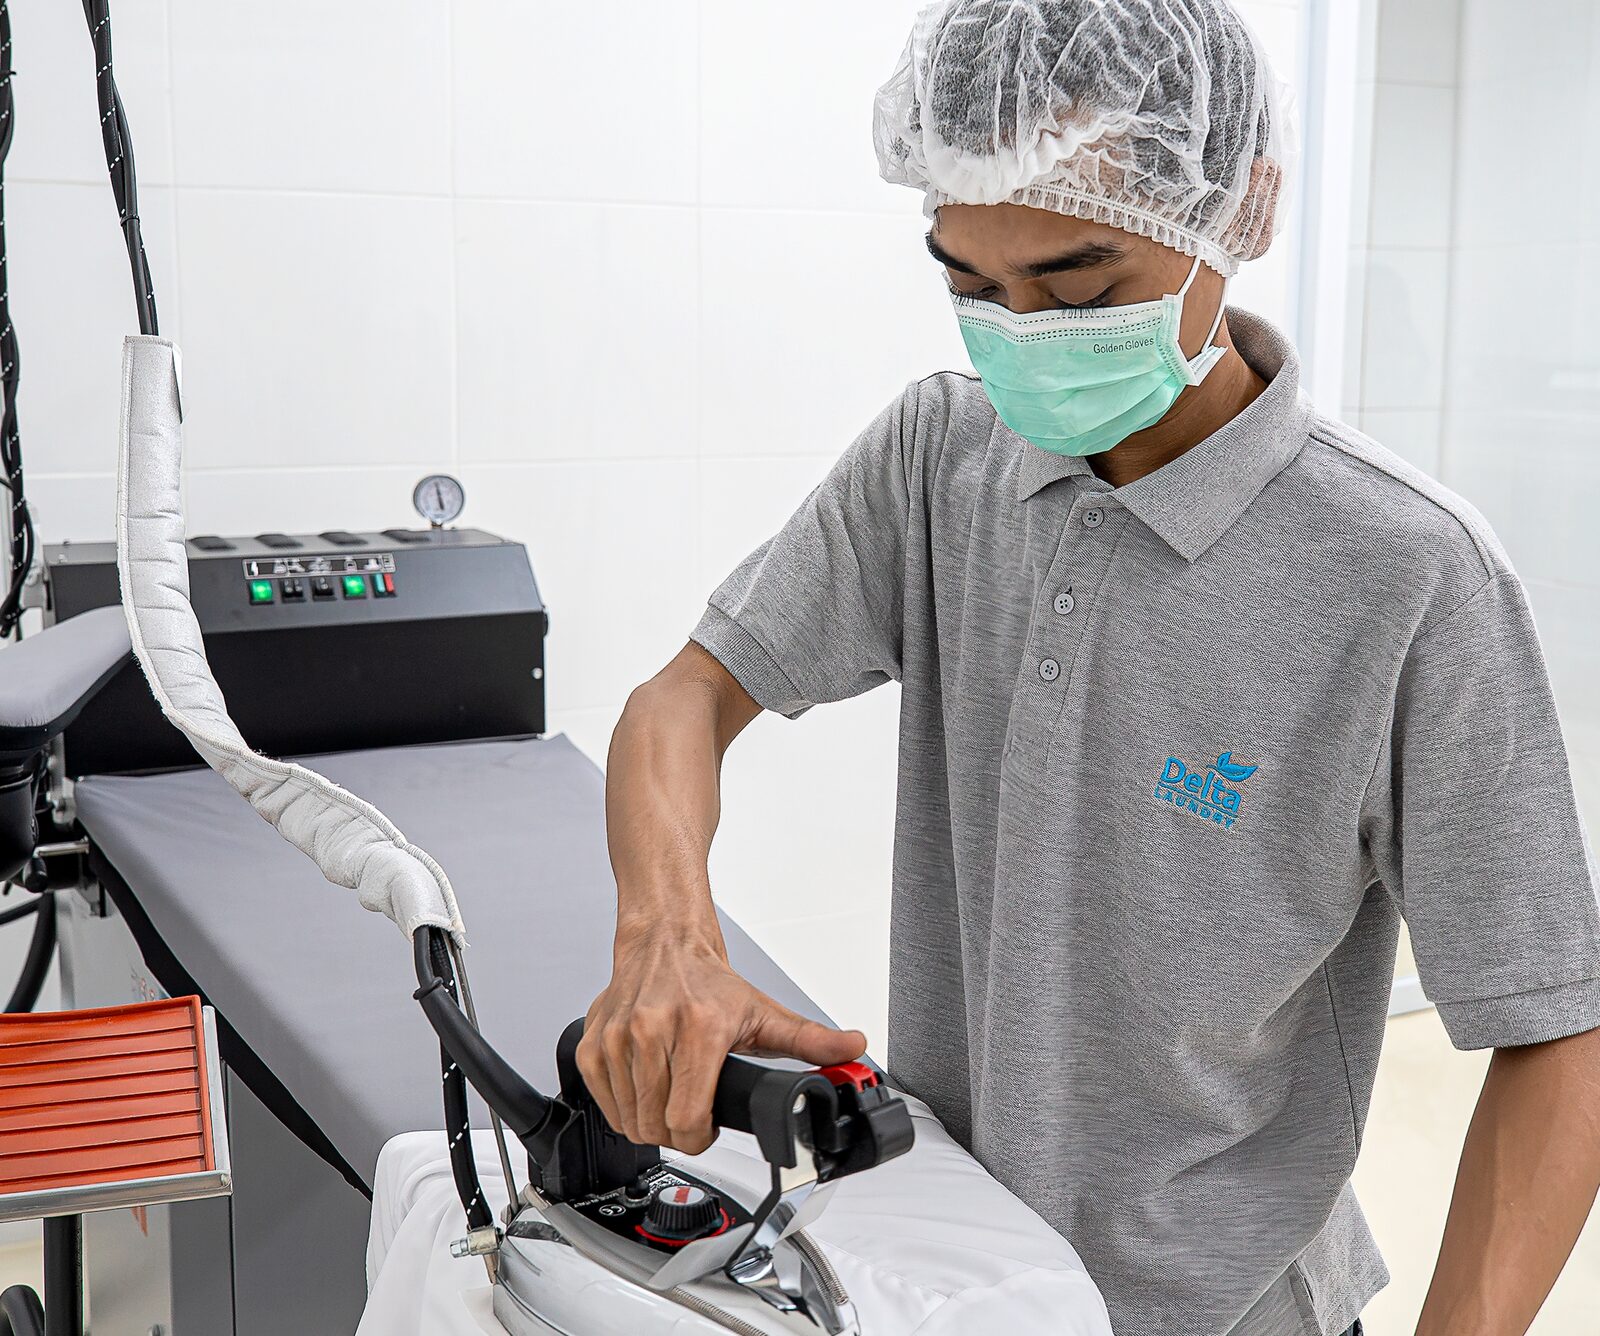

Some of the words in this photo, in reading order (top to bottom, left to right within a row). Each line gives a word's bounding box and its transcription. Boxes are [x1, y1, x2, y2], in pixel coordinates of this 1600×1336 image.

[1093, 343, 1124, 354] Golden
[1125, 337, 1155, 351] Gloves
[1153, 784, 1236, 829] LAUNDRY
[1160, 756, 1242, 813] Delta
